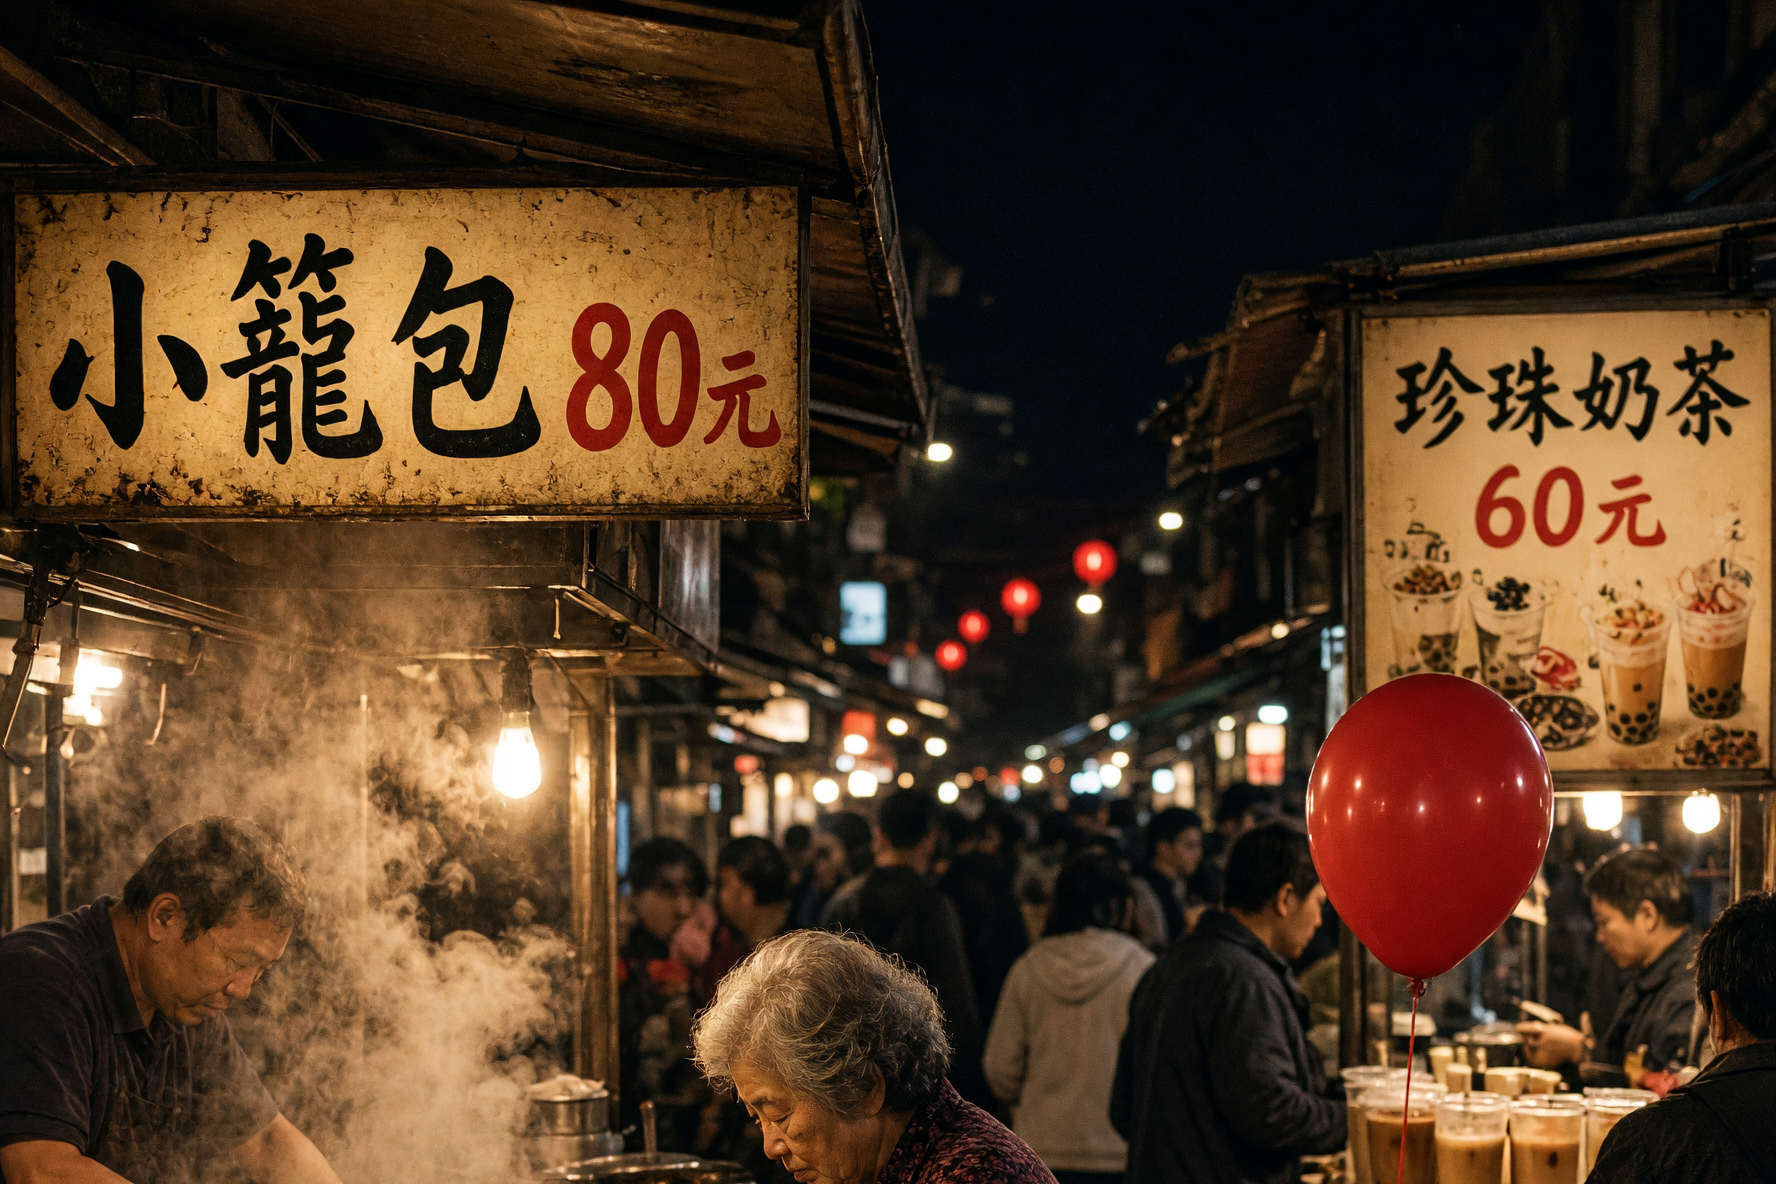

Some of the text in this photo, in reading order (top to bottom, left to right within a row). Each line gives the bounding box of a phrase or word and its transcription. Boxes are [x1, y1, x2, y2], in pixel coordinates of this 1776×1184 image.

[49, 233, 781, 464] 小籠包 80元
[1395, 340, 1750, 448] 珍珠奶茶
[1476, 465, 1667, 548] 60元
